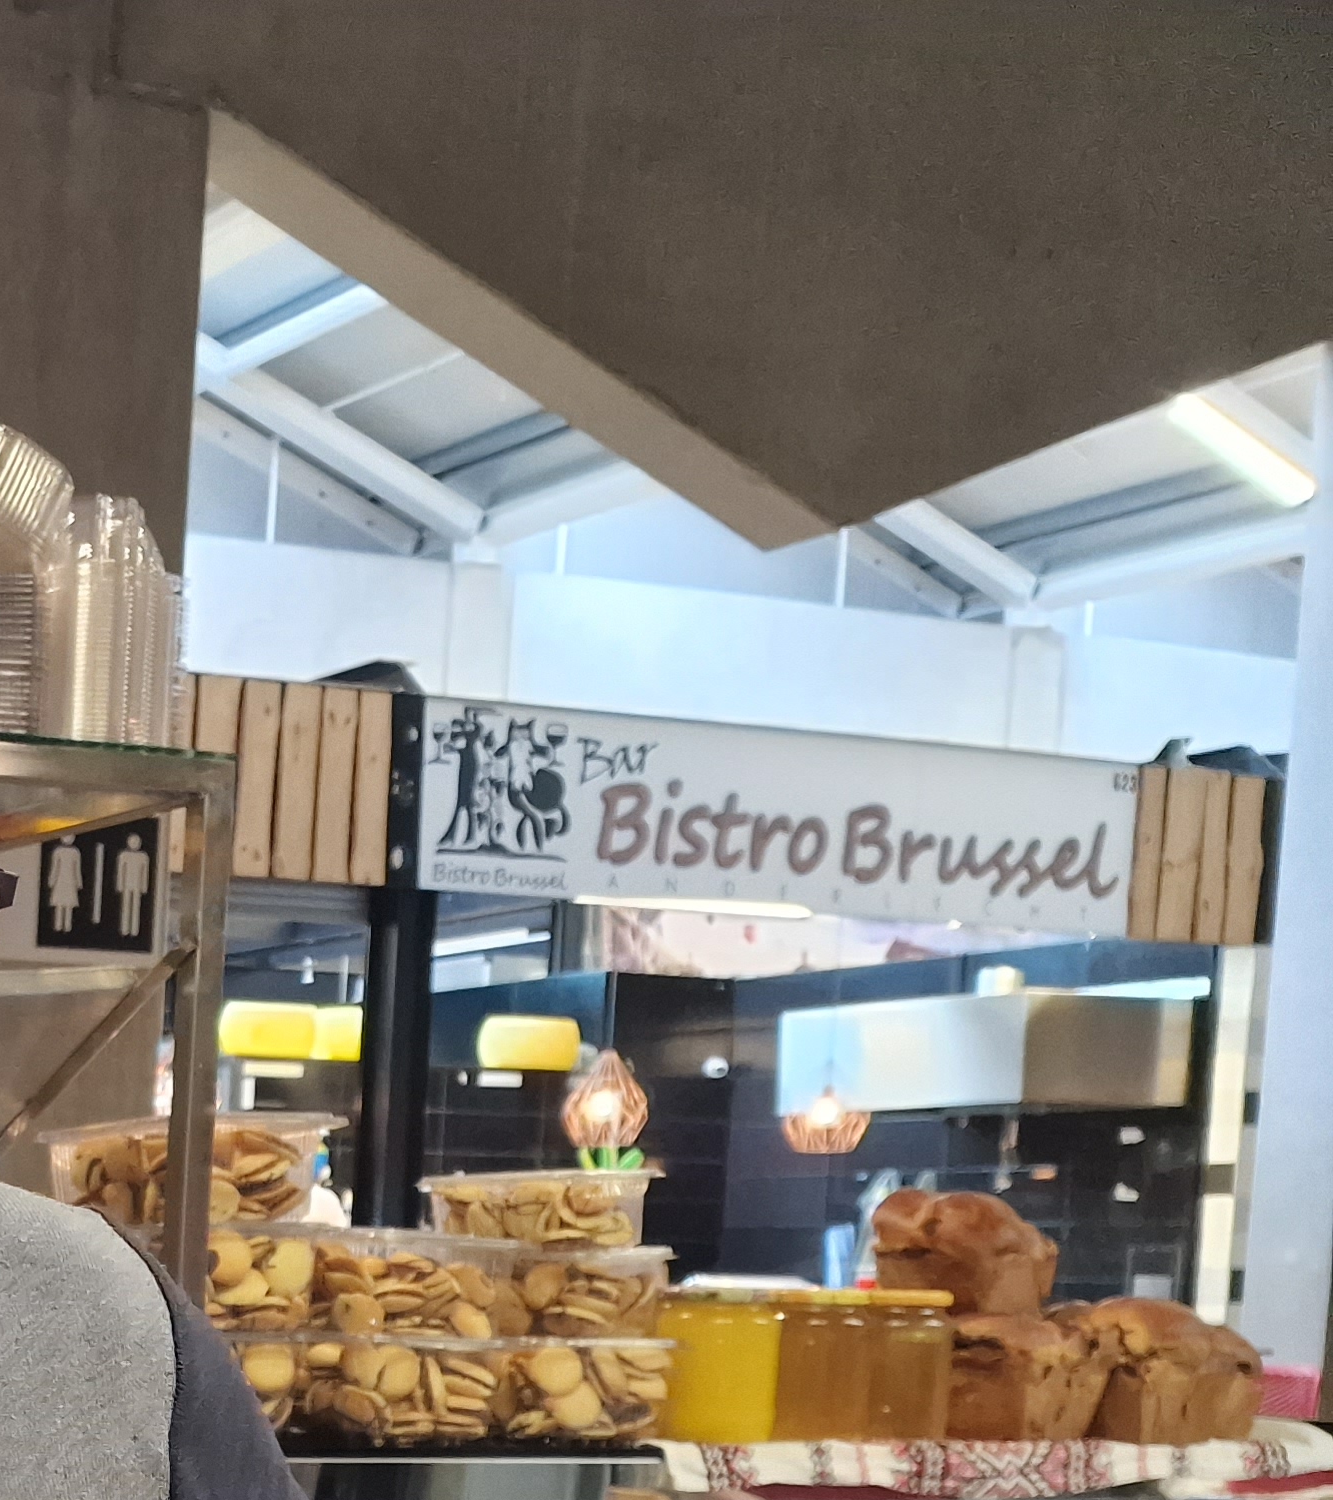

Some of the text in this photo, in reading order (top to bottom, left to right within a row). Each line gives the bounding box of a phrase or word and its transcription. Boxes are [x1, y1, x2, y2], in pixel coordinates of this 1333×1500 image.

[576, 737, 659, 785] Bar
[597, 779, 1119, 899] Bistro Brussel
[433, 862, 569, 890] Bistro Brussel
